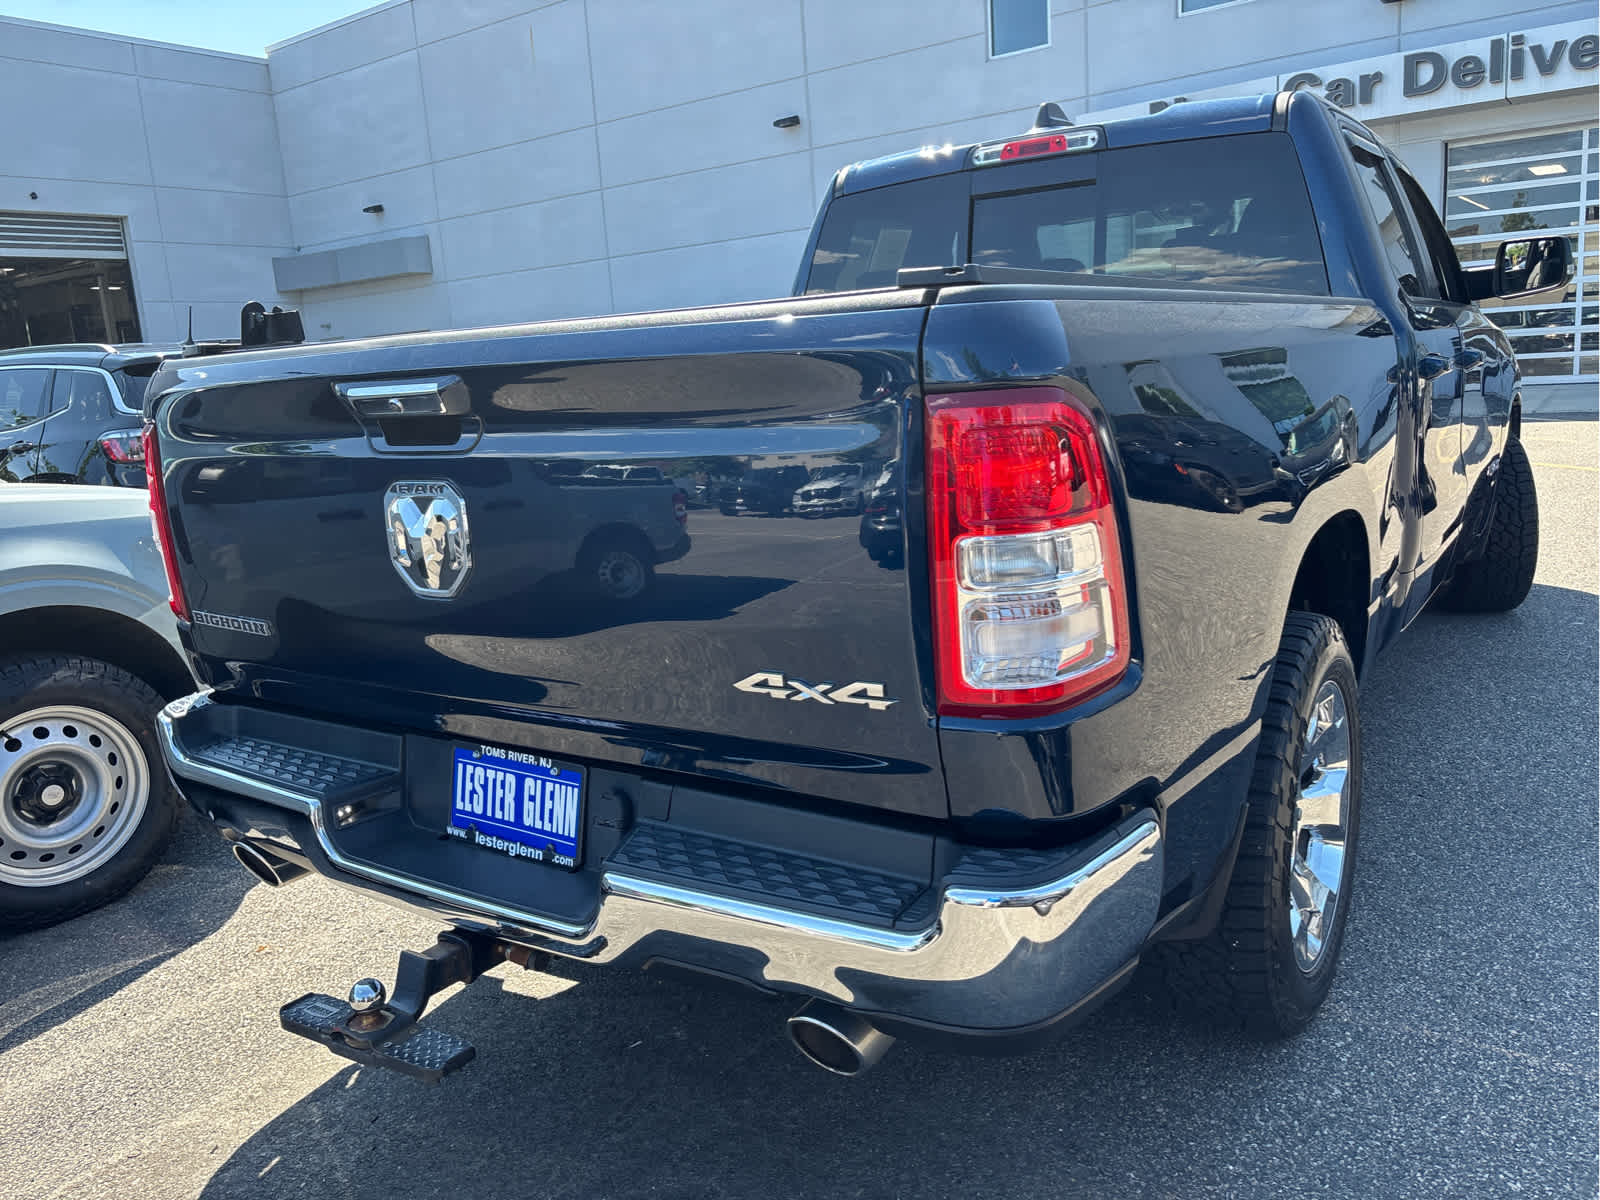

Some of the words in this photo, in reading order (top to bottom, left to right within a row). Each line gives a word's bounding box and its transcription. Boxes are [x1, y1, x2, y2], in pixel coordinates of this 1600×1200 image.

[396, 484, 444, 495] RAM
[480, 745, 506, 759] TOMS
[508, 751, 538, 766] RIVER,
[539, 757, 552, 769] NJ
[456, 762, 517, 822] LESTER
[523, 777, 579, 838] GLENN
